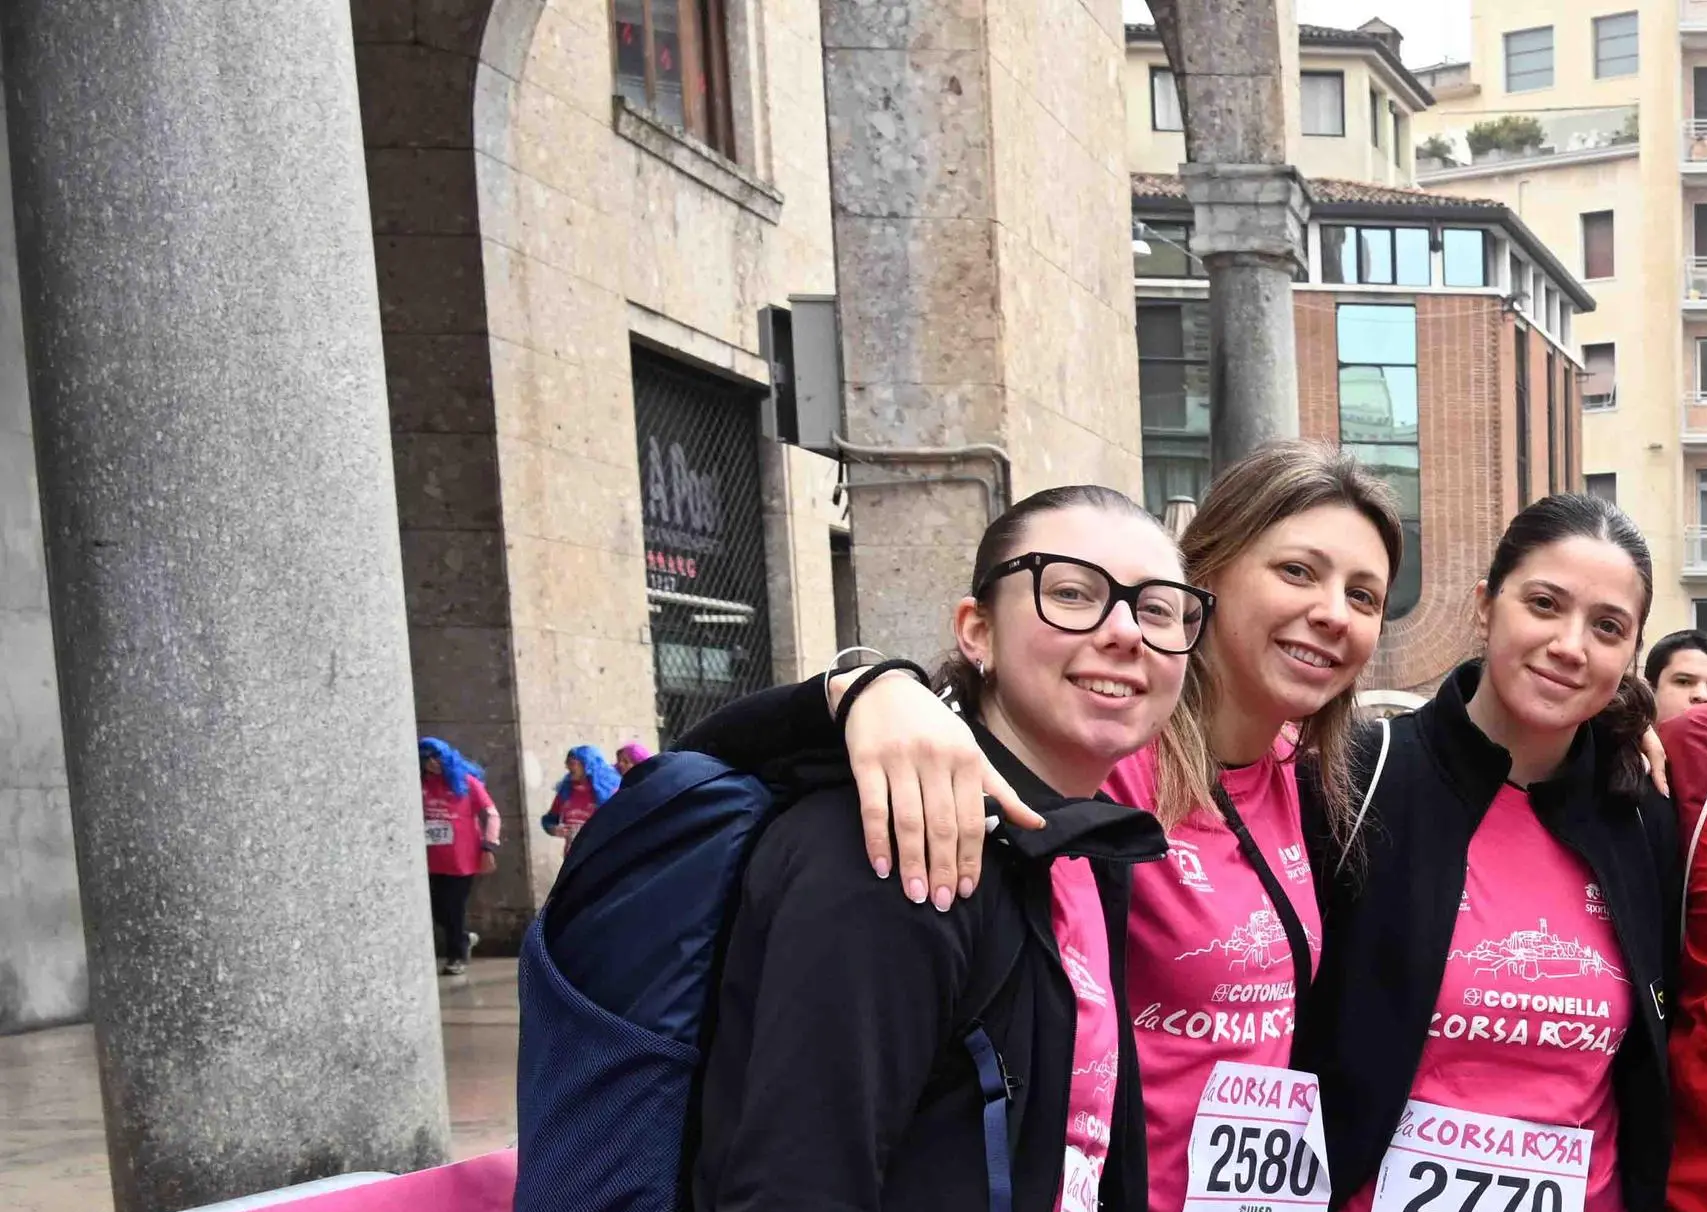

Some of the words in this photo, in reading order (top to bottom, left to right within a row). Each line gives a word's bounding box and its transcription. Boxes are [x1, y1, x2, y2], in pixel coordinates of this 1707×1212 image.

[1484, 990, 1610, 1018] COTONELLA
[1134, 1003, 1161, 1031] la
[1162, 1008, 1256, 1045] CORSA
[1537, 1020, 1612, 1053] ROSA
[1216, 1076, 1282, 1109] CORSA
[1395, 1109, 1415, 1138] la
[1416, 1116, 1515, 1157] CORSA
[1521, 1131, 1583, 1165] ROSA
[1206, 1124, 1320, 1197] 2580
